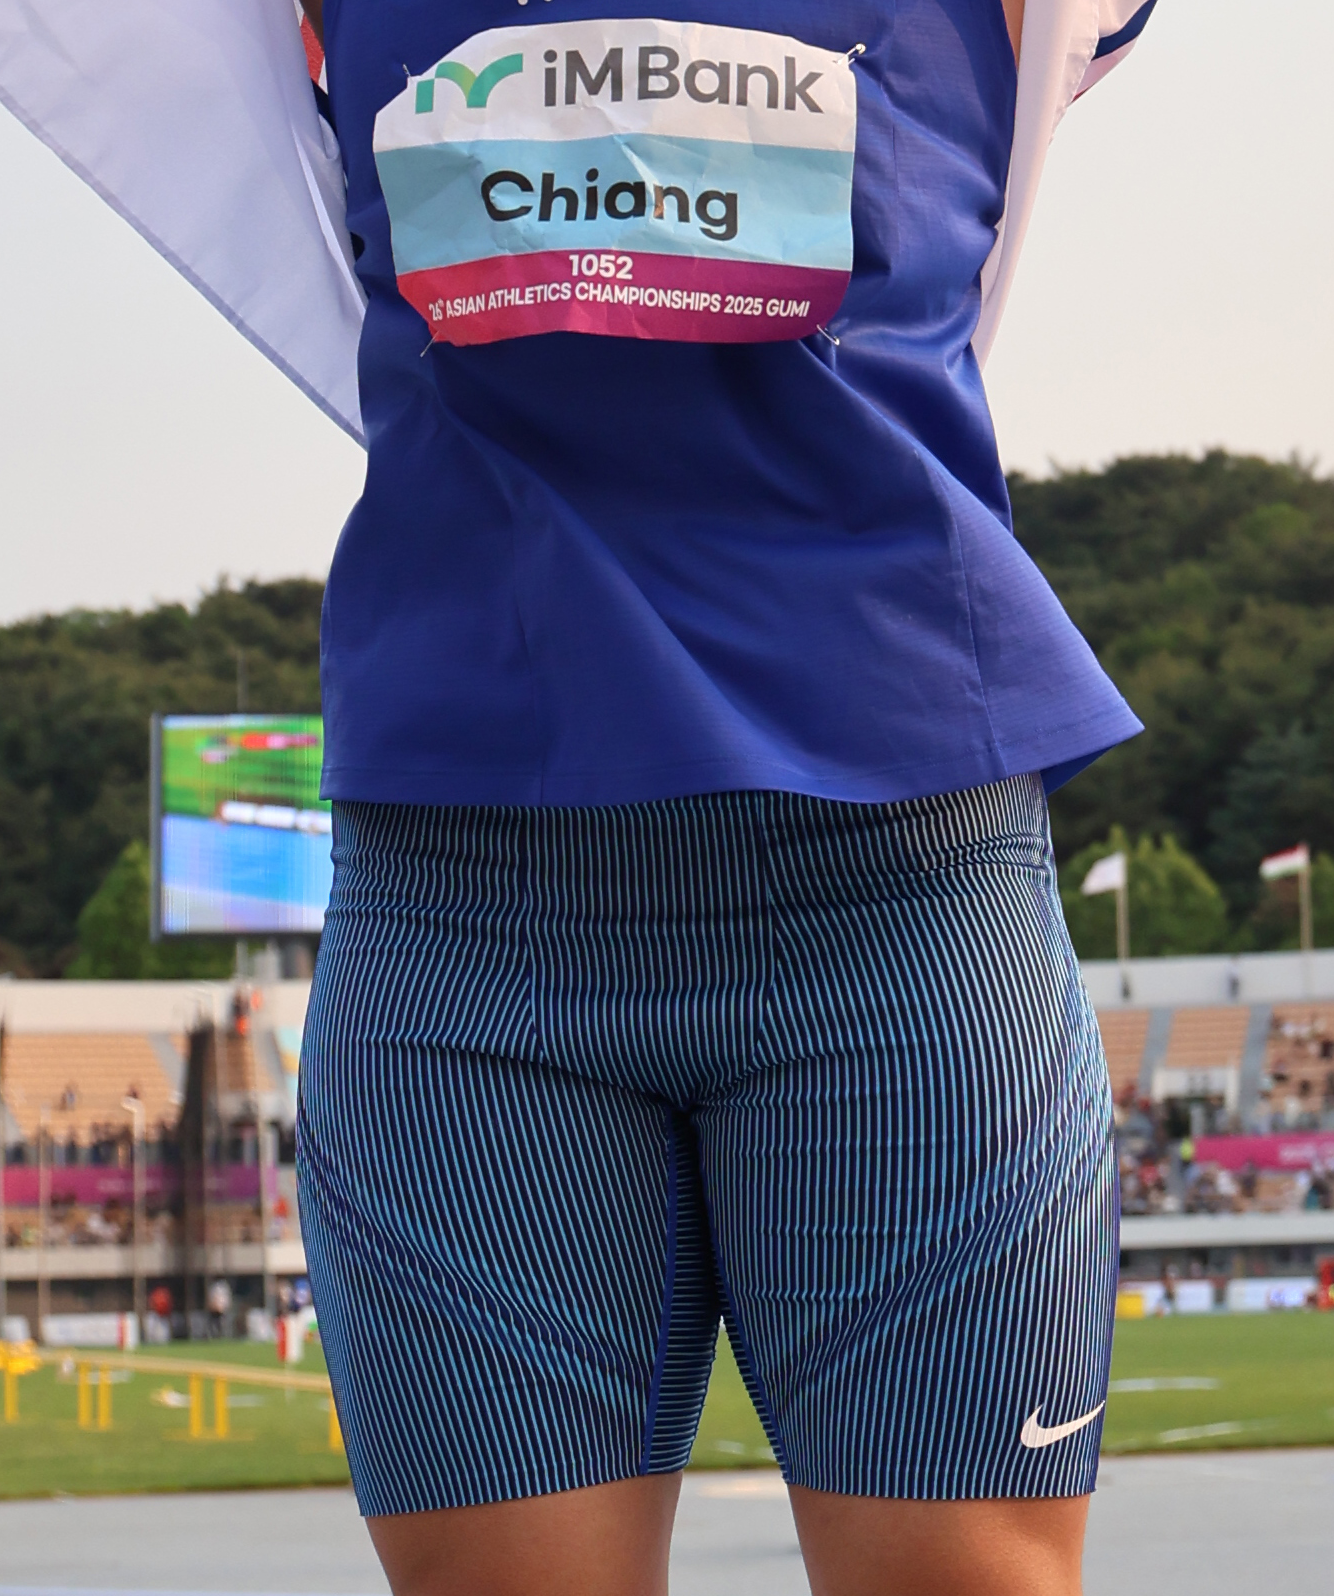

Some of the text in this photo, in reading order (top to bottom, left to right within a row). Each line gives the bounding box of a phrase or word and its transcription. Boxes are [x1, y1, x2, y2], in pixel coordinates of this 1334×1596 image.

[480, 167, 739, 242] Chiang
[568, 253, 634, 280] 1052
[445, 293, 486, 319] ASIAN
[487, 281, 572, 311] ATHLETICS
[574, 281, 722, 313] CHAMPIONSHIPS
[723, 294, 764, 316] 2025
[765, 298, 811, 318] GUMI
